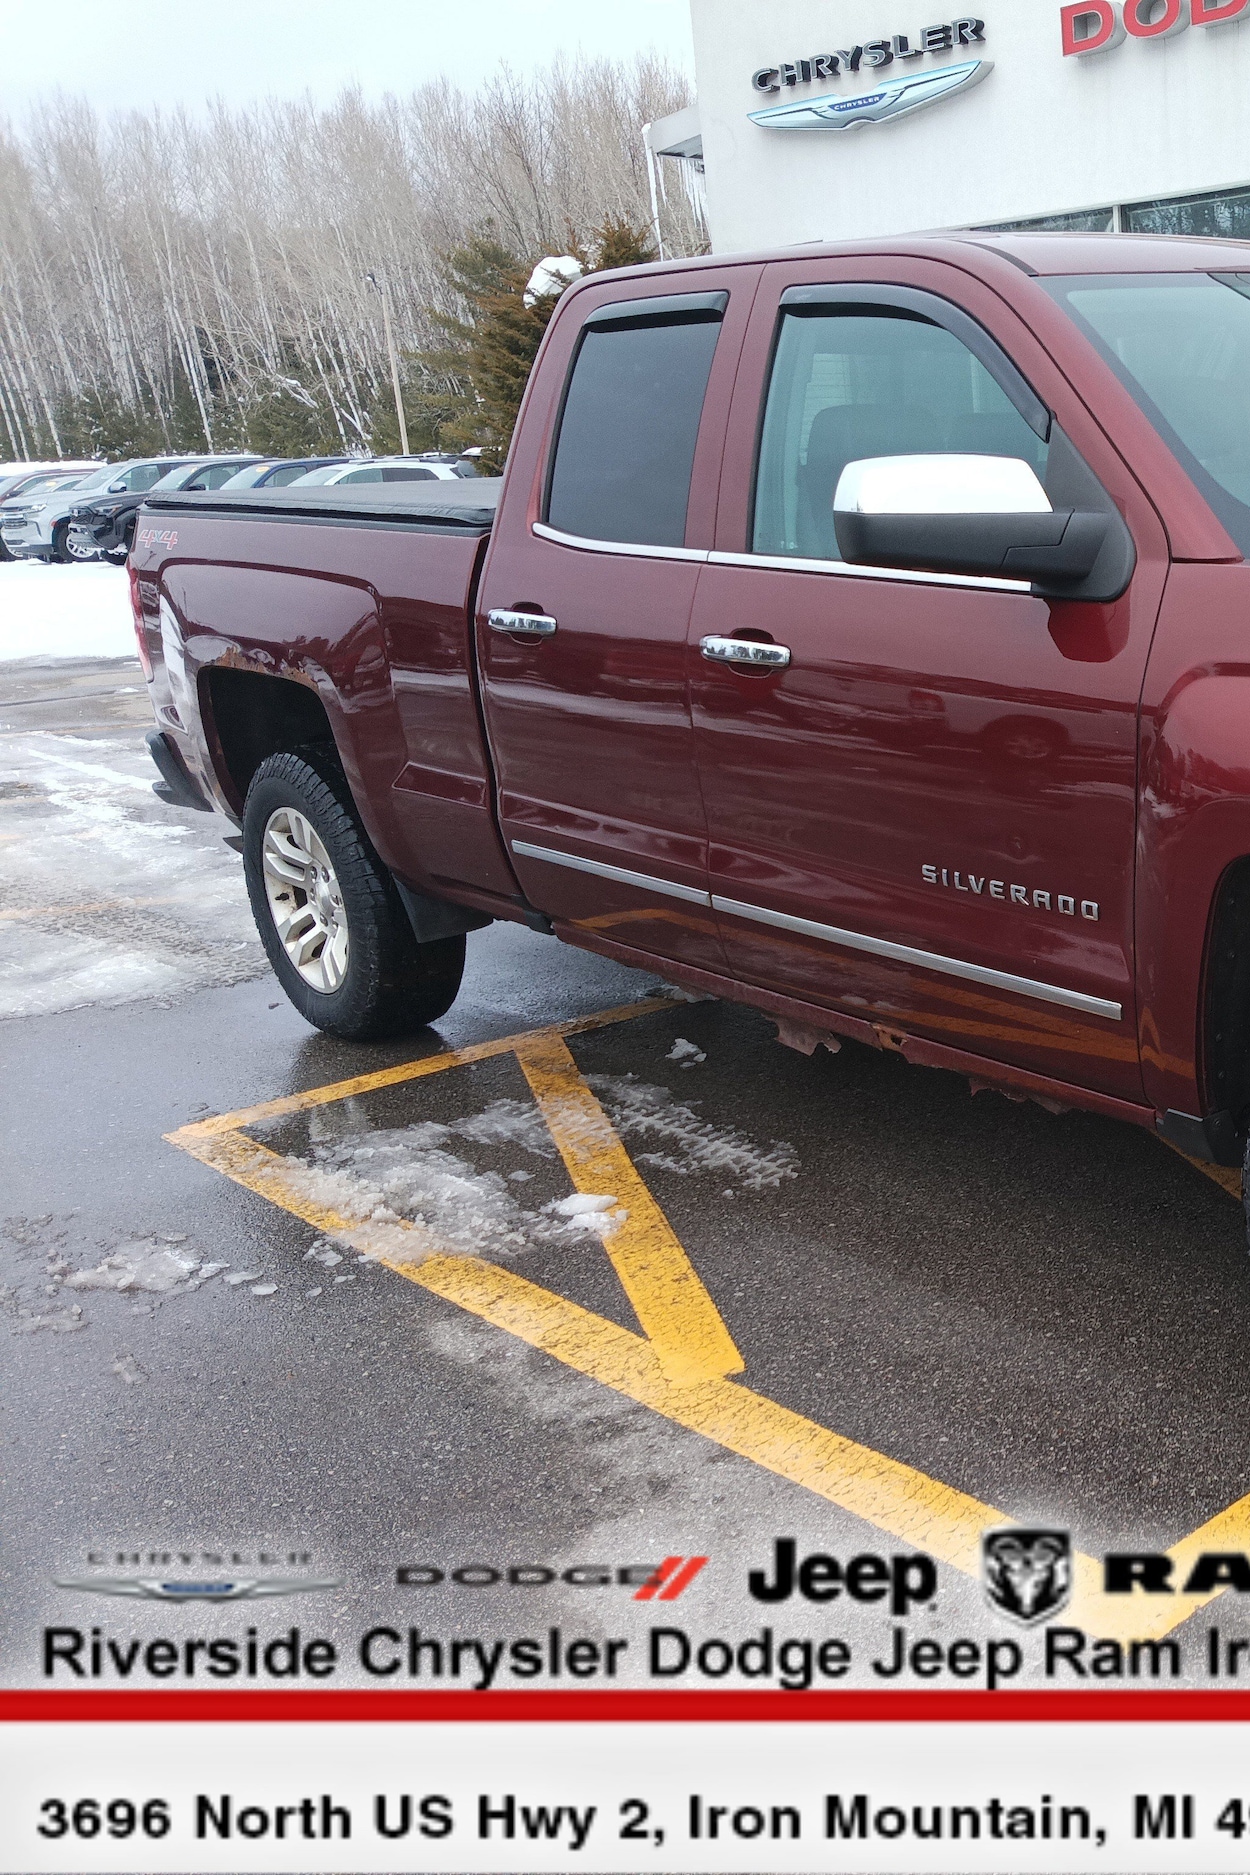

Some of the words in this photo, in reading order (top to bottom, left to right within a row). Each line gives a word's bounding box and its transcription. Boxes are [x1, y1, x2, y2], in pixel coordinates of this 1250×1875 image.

[751, 16, 982, 93] CHRYSLER
[833, 96, 881, 111] CHRYSLER
[921, 864, 1099, 921] SILVERADO
